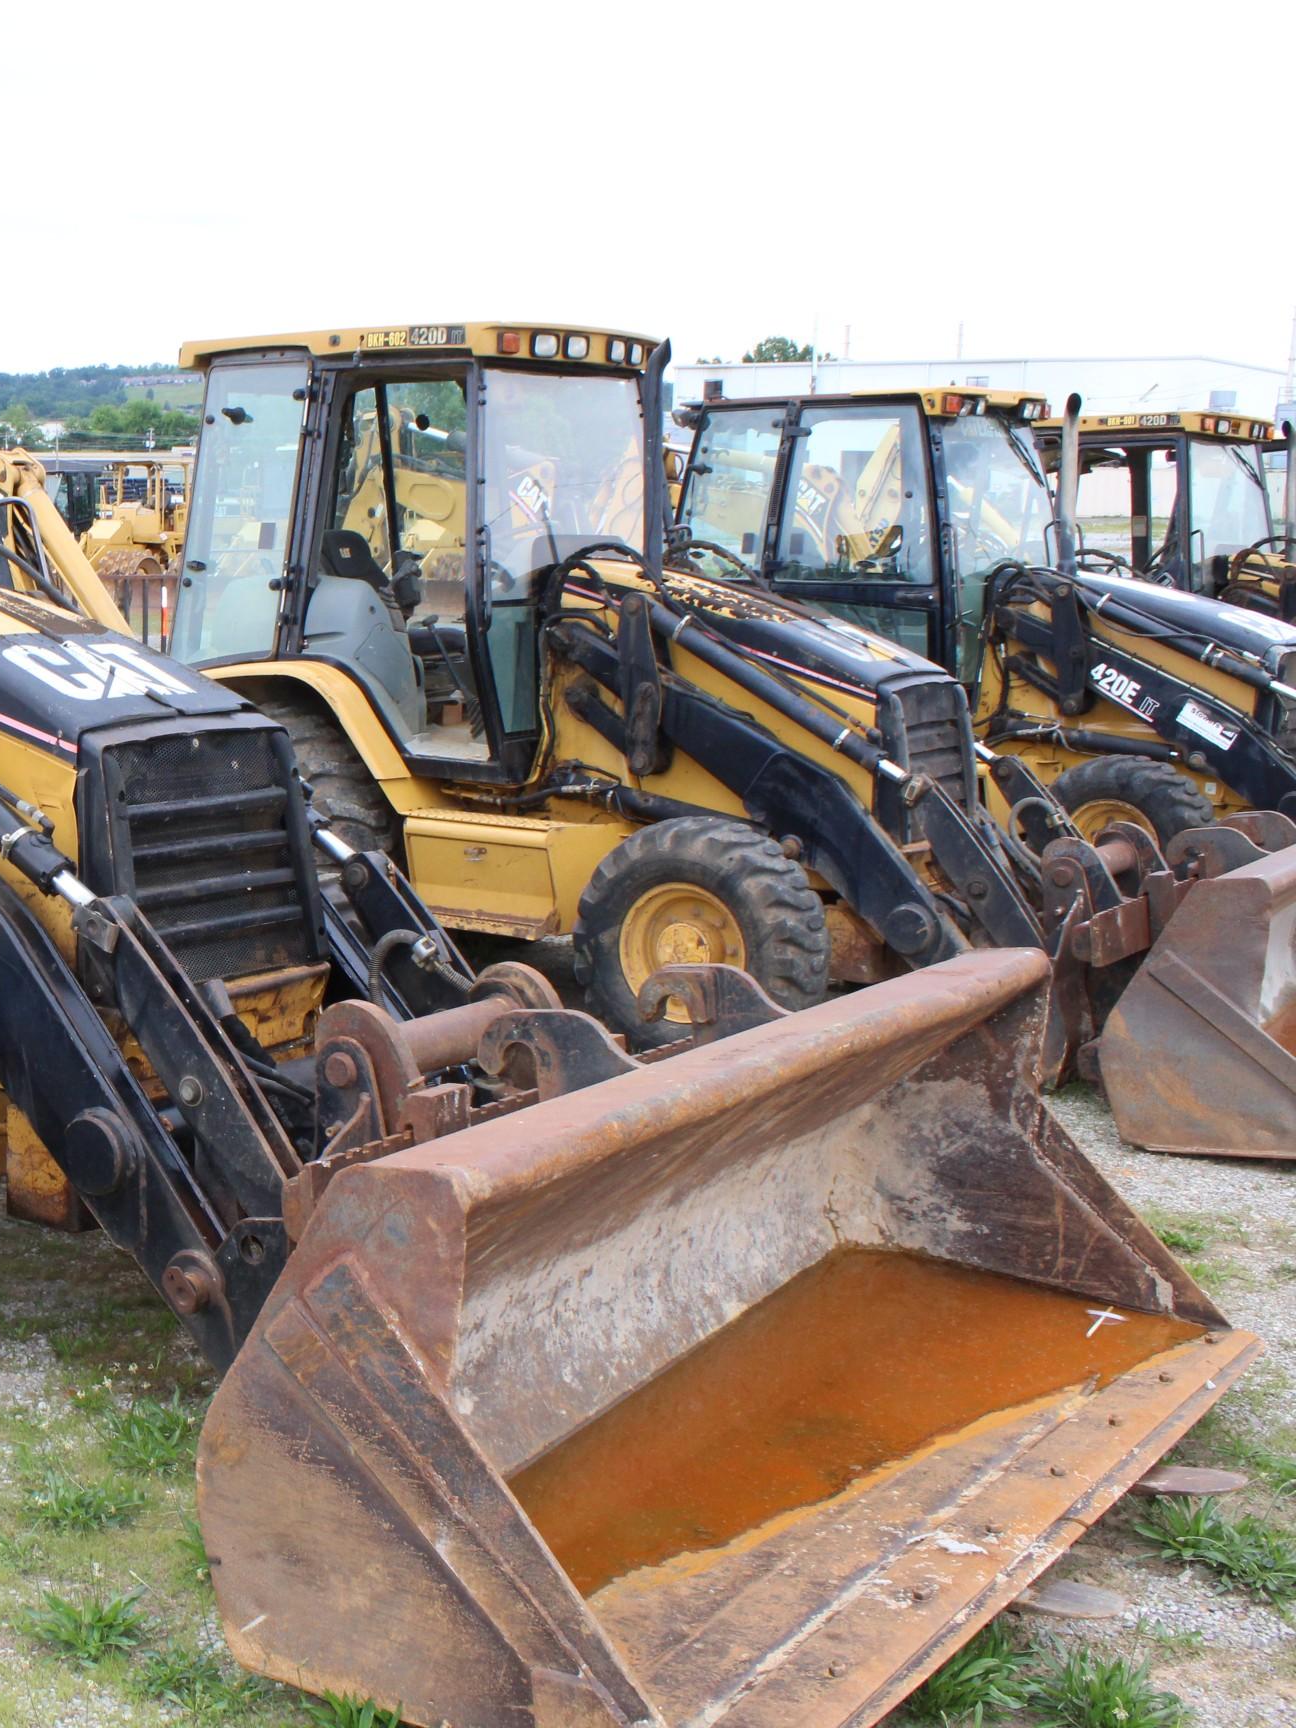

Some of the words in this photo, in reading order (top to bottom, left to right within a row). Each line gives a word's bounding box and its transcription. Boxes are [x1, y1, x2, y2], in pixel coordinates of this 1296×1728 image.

[410, 327, 447, 345] 420D
[1139, 414, 1167, 426] 420D
[517, 475, 548, 514] CAT
[797, 479, 826, 516] CAT
[2, 640, 198, 701] CAT
[1090, 663, 1142, 705] 420E
[1139, 696, 1160, 716] IT
